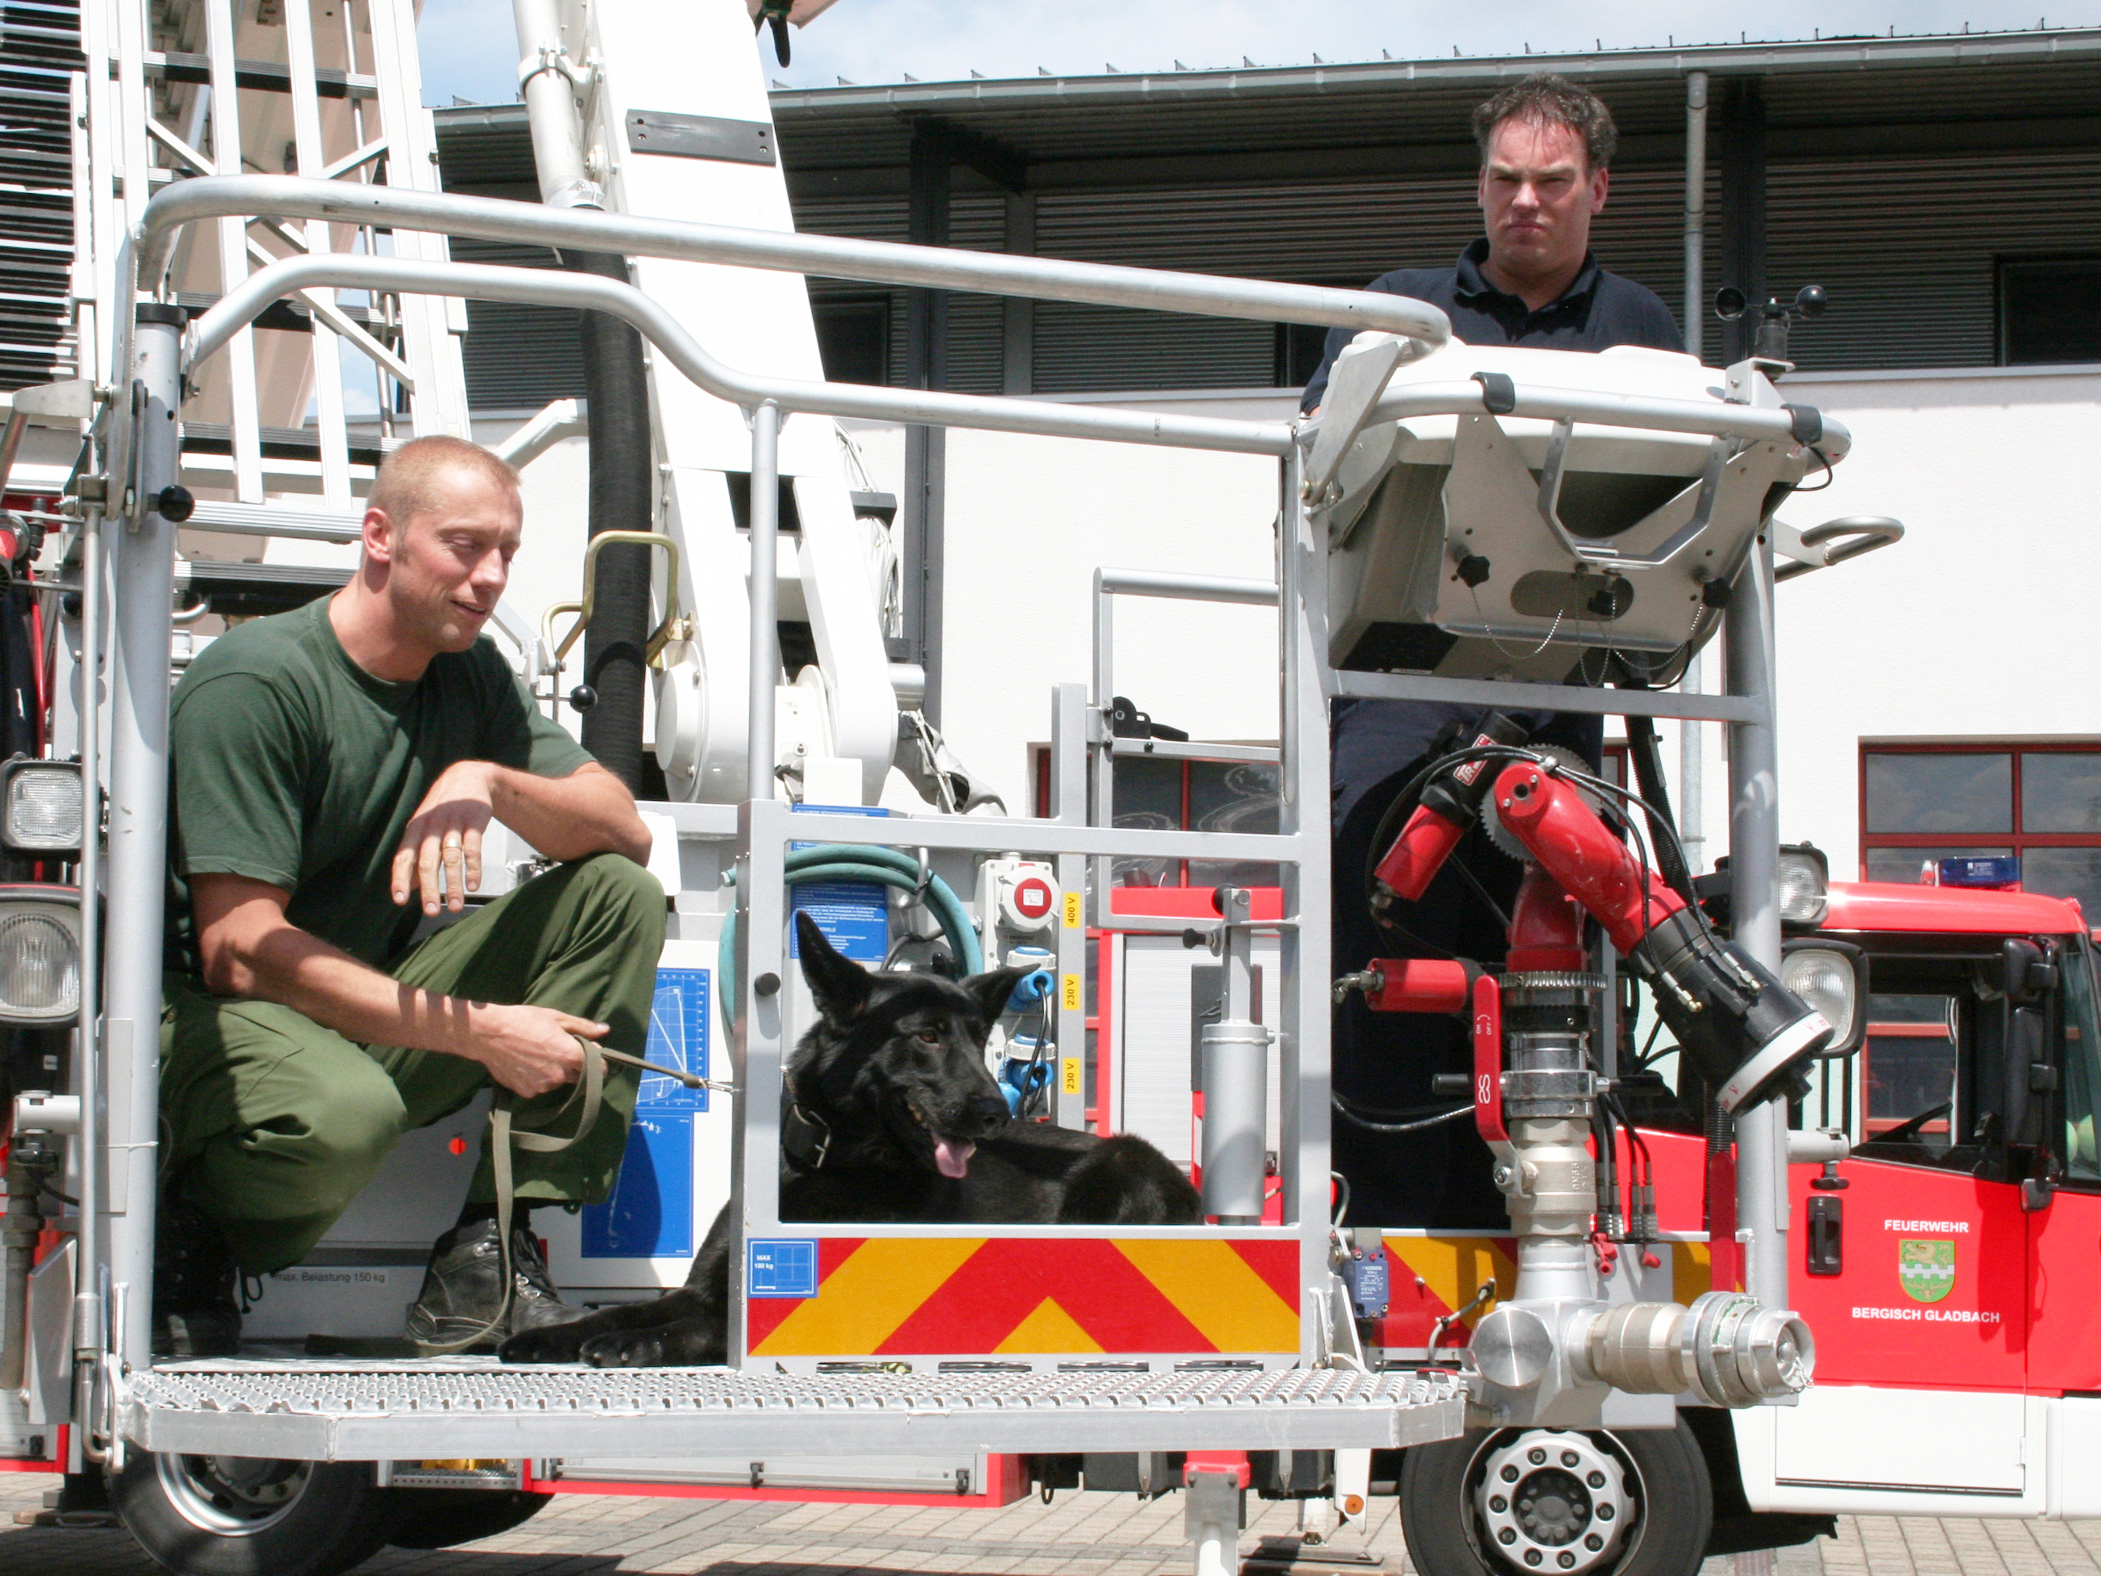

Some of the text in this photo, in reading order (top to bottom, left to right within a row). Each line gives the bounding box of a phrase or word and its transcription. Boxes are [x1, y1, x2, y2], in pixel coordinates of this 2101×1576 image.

[1067, 897, 1076, 924] 400 V
[1067, 988, 1075, 1006] 230
[1067, 1071, 1075, 1089] 230
[1884, 1219, 1969, 1233] FEUERWEHR
[765, 1262, 774, 1270] kg
[302, 1272, 351, 1283] Belastung
[354, 1272, 371, 1281] 150
[373, 1272, 385, 1283] kg
[1852, 1306, 2000, 1323] BERGISCH GLADBACH
